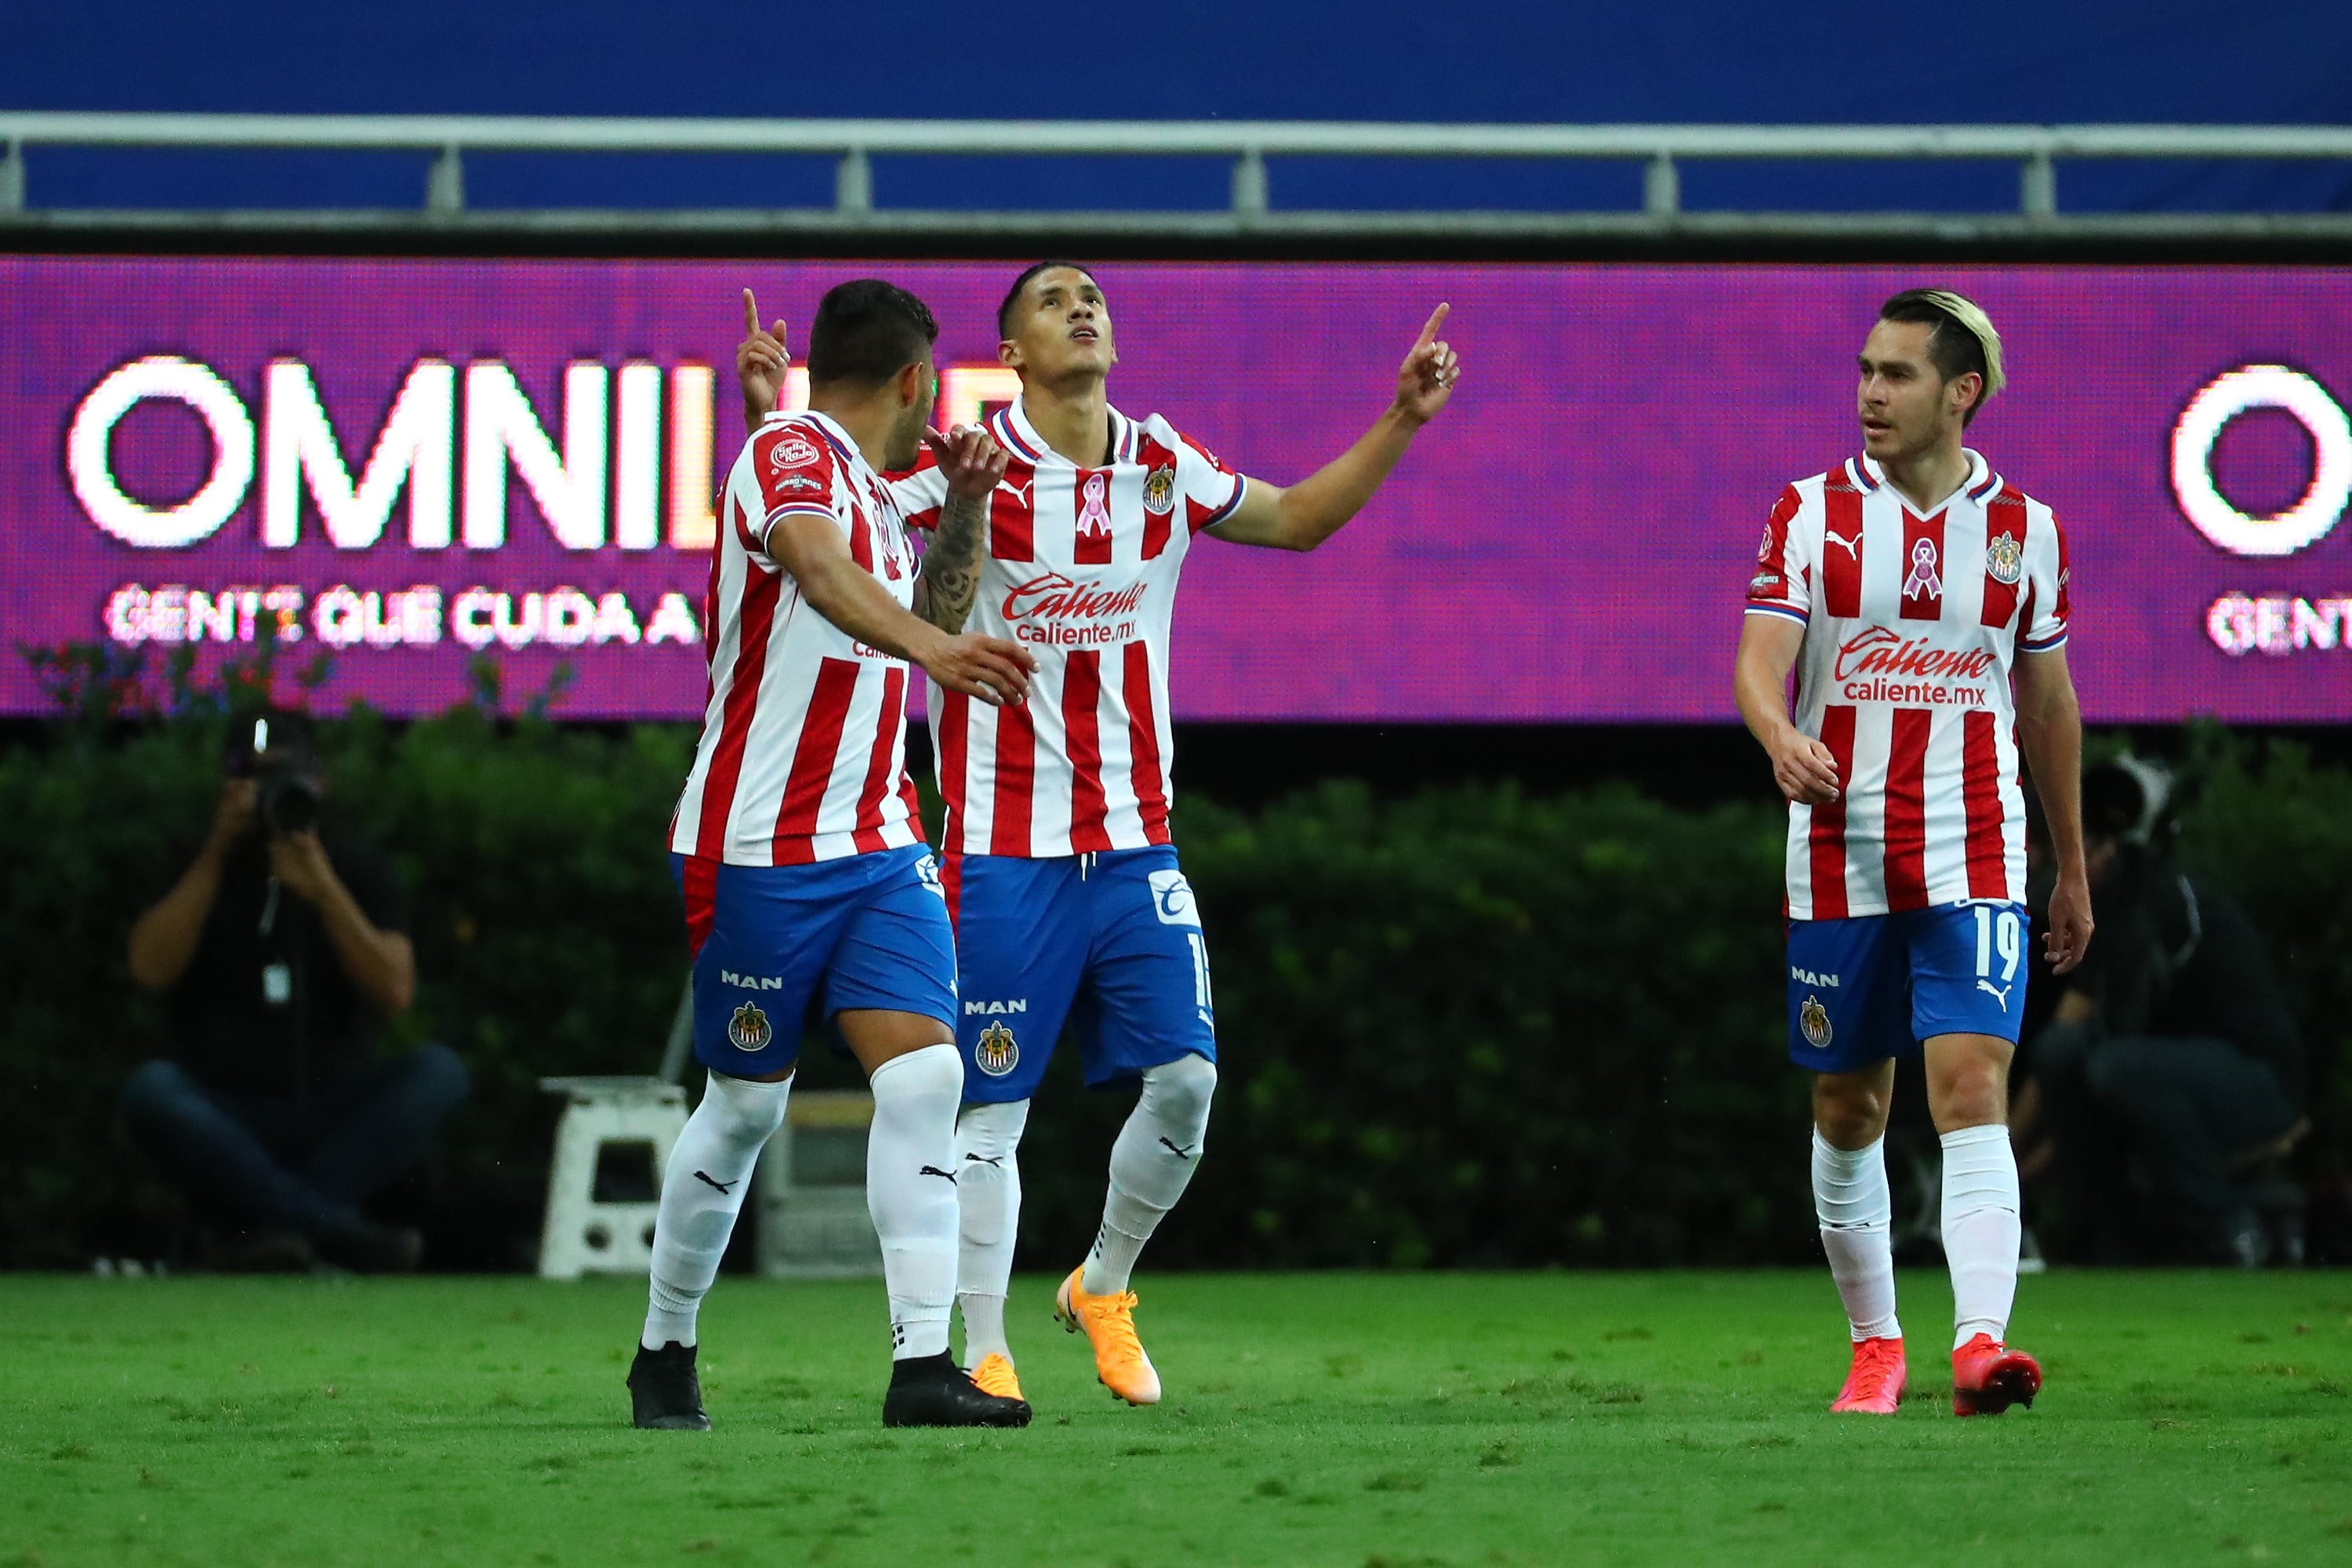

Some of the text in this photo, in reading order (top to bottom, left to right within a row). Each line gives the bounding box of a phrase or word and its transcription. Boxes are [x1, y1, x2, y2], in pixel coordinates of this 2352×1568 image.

[314, 585, 443, 648] QUE
[1016, 620, 1137, 645] caliente.mx
[1835, 625, 1996, 682] Caliente
[1844, 677, 1987, 706] caliente.mx
[1974, 905, 2020, 982] 19
[721, 969, 782, 989] MAN
[1791, 965, 1839, 987] MAN
[965, 998, 1027, 1016] MAN
